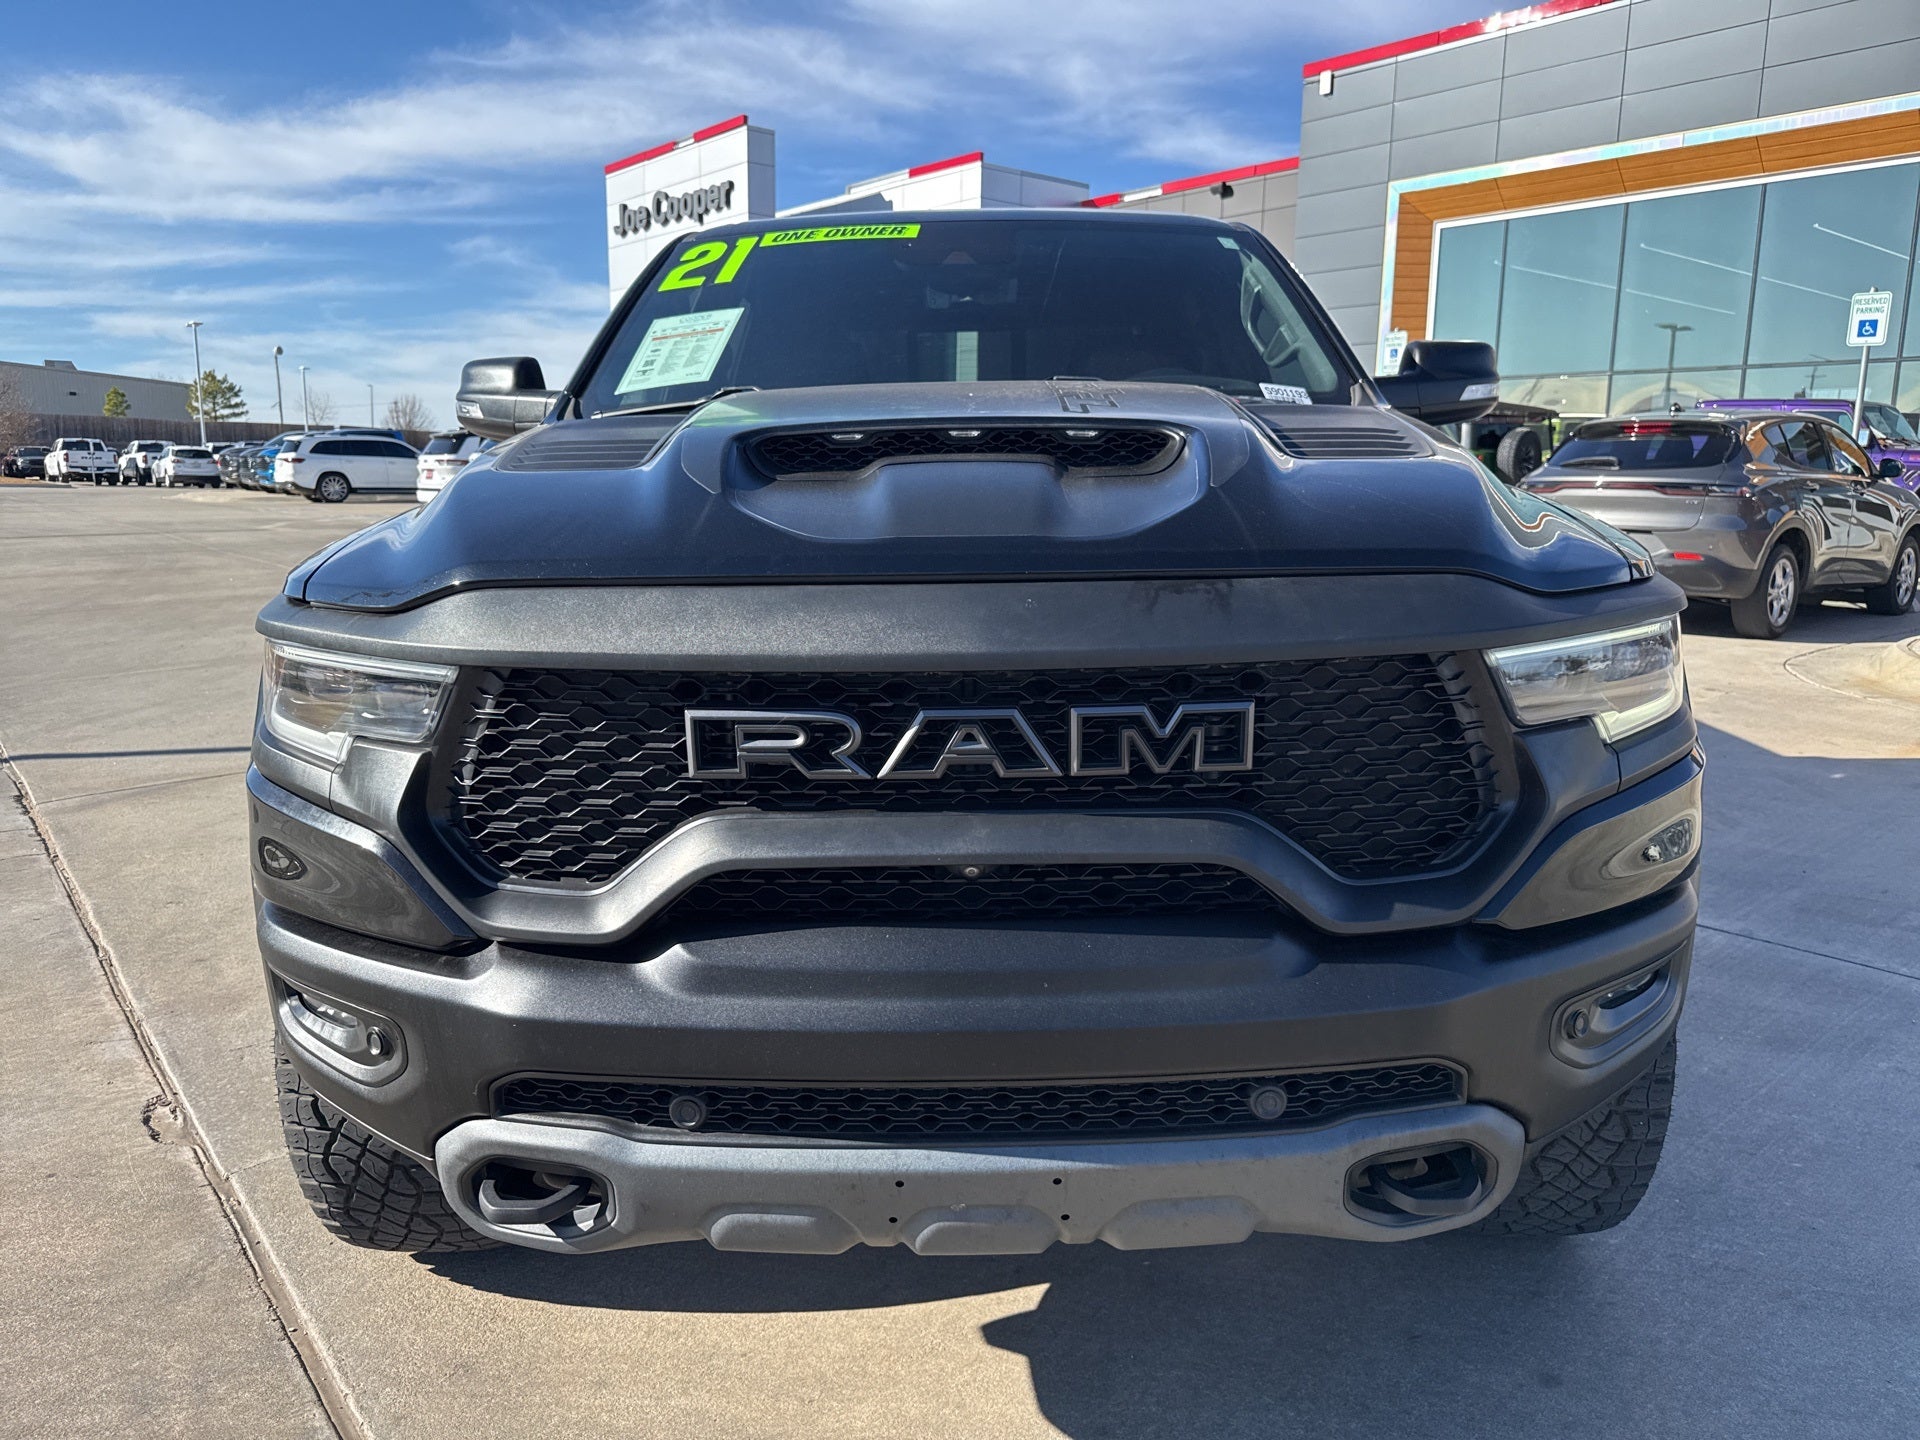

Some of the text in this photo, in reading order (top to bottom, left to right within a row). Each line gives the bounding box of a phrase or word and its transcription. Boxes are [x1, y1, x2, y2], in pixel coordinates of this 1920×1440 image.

[613, 180, 735, 238] Joe Cooper
[771, 226, 908, 242] ONE OWNER
[657, 236, 759, 292] 21
[1855, 296, 1889, 305] RESERVED
[1856, 306, 1885, 314] PARKING
[1264, 386, 1309, 399] S901193
[684, 701, 1255, 780] RAM
